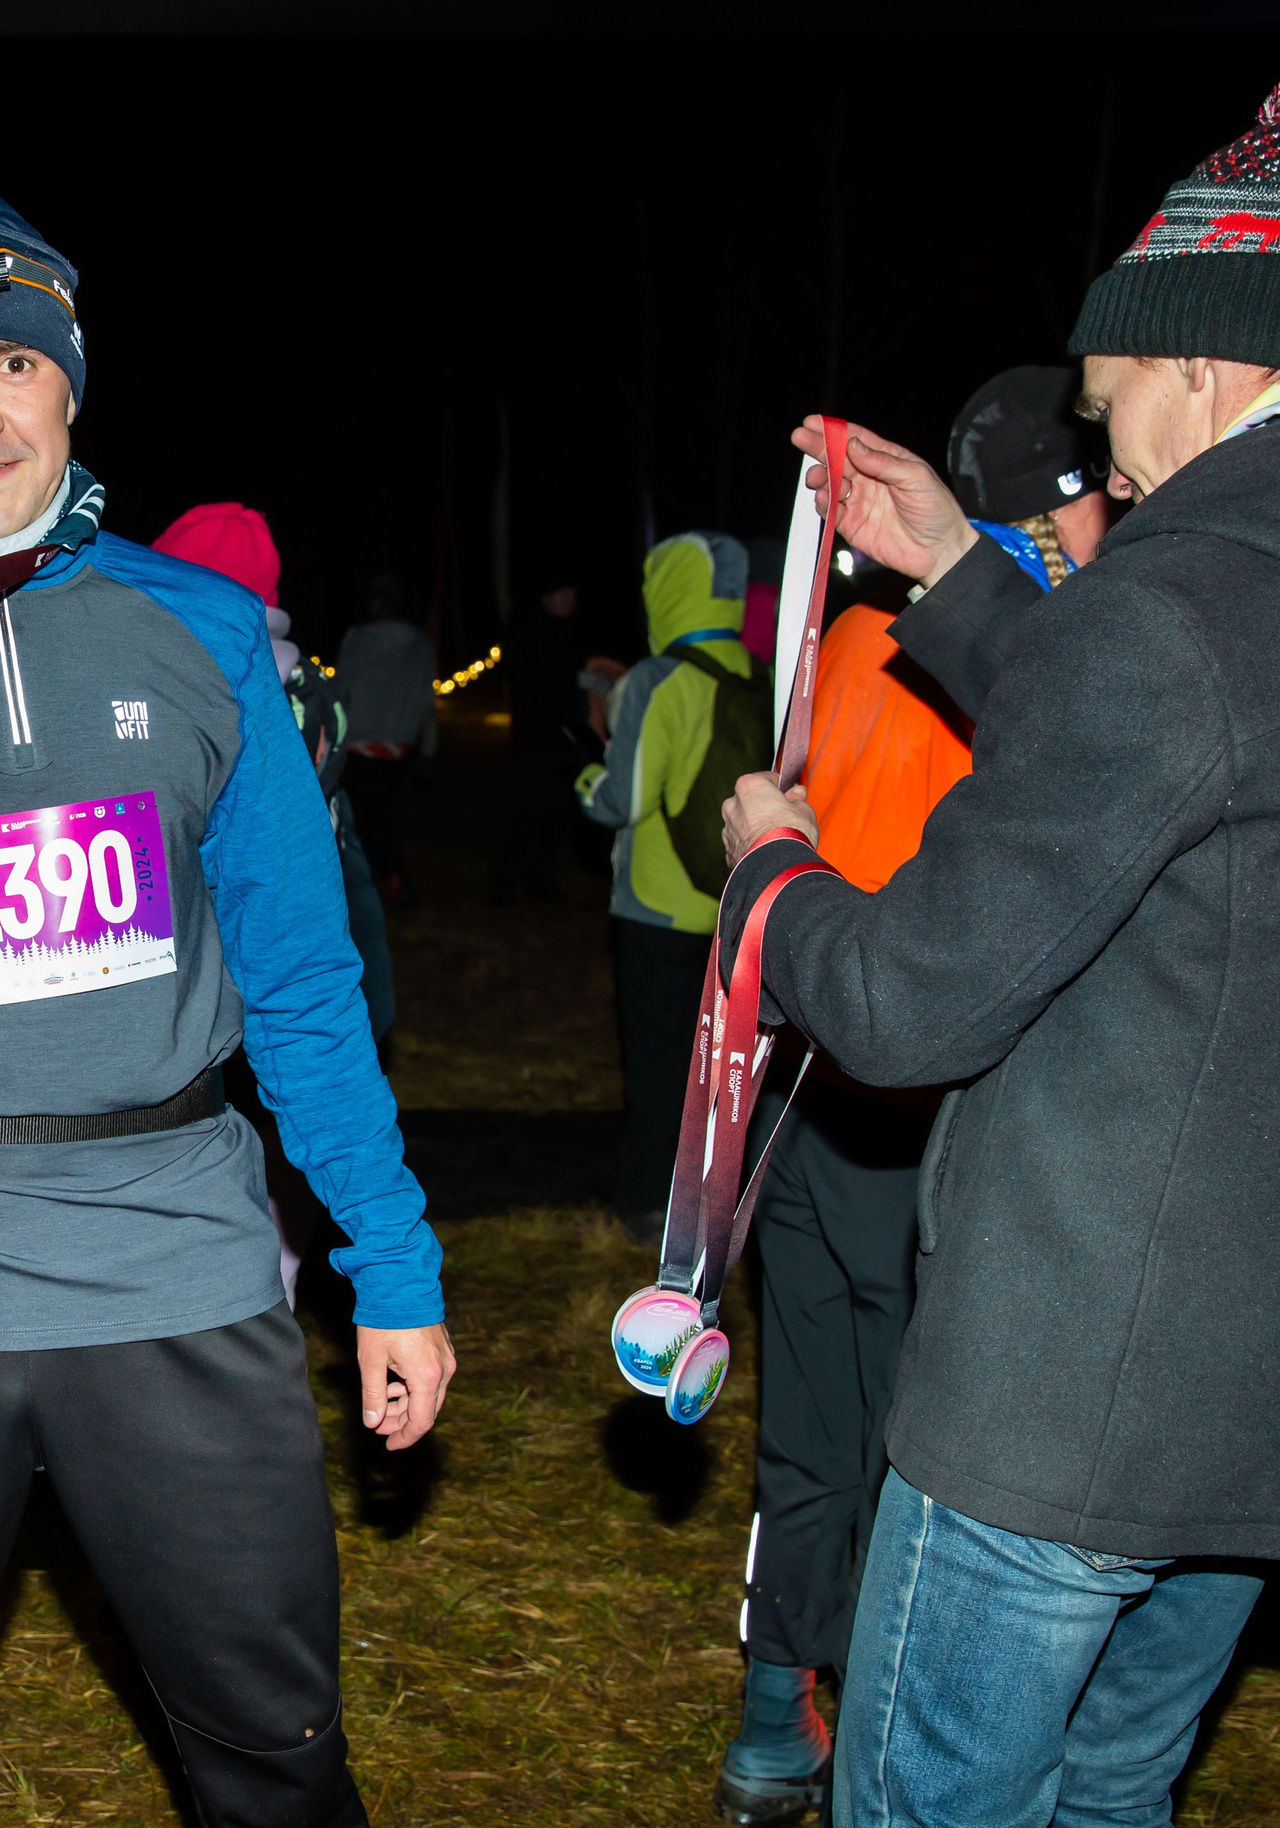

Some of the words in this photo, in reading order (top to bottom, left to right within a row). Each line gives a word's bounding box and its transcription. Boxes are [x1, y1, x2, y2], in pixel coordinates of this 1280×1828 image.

[127, 720, 149, 740] FIT
[137, 846, 155, 892] 2024
[727, 1068, 736, 1094] СПОРТ
[731, 1069, 743, 1123] КАЛАШНИКОВ
